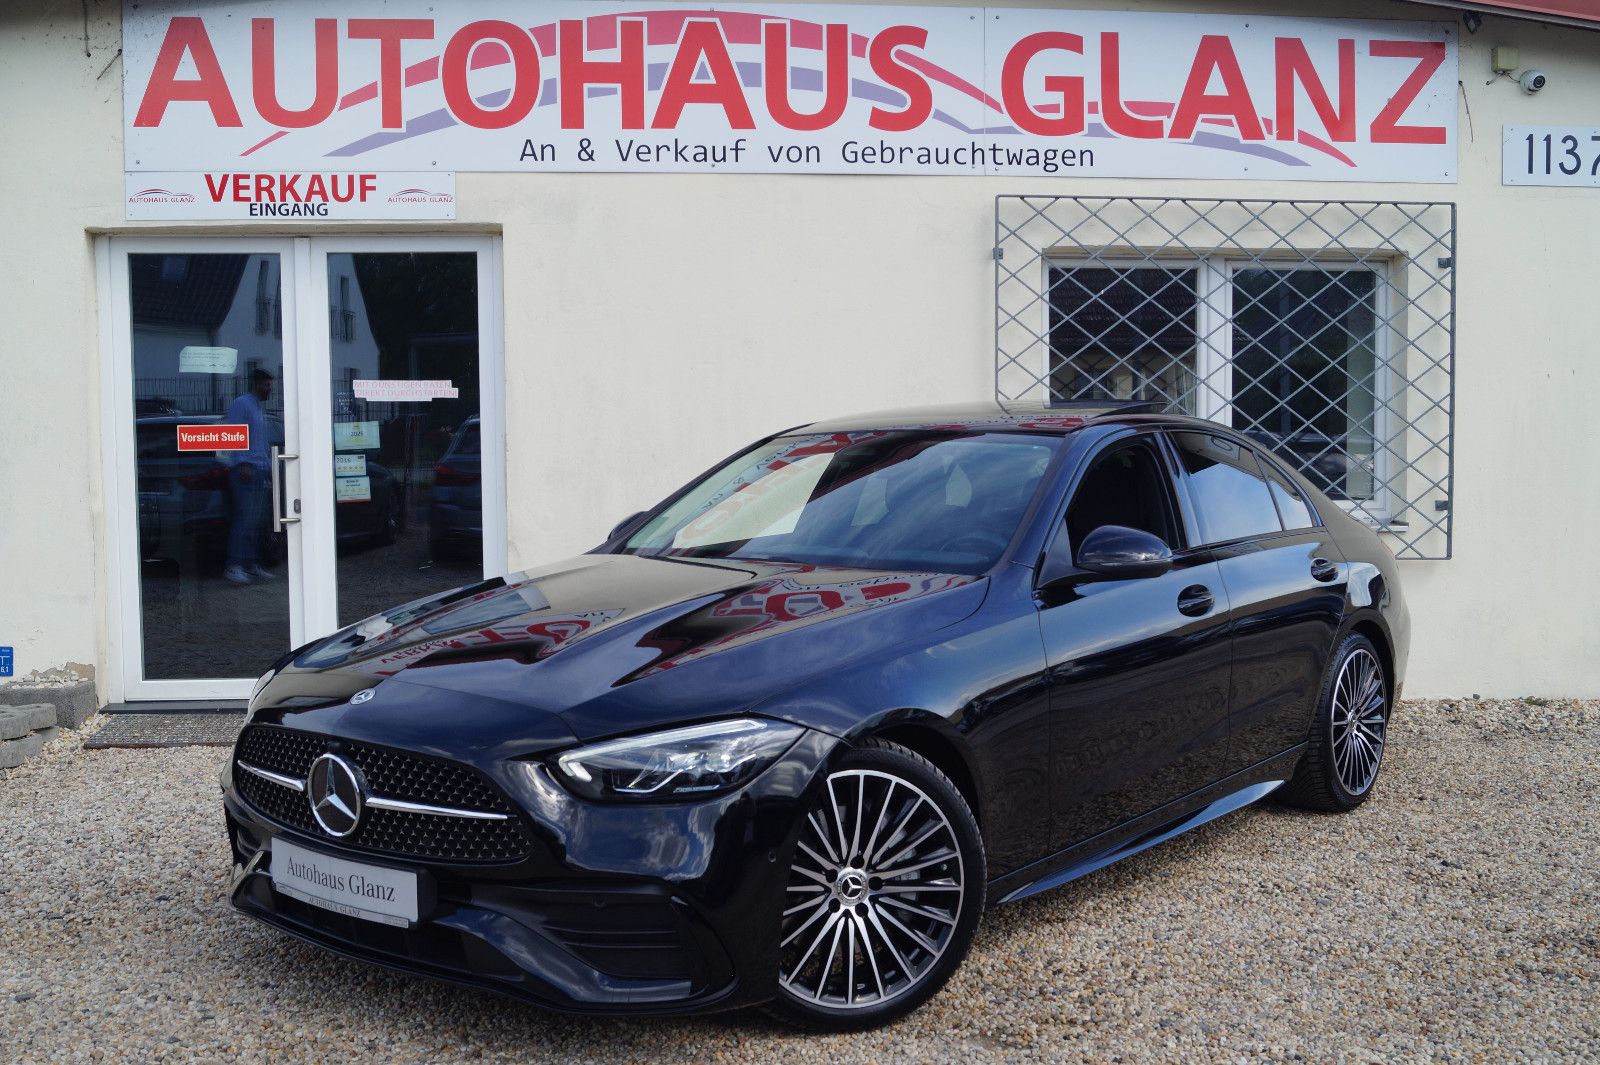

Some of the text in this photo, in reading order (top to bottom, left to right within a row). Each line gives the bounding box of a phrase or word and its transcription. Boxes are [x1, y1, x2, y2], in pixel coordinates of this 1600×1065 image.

[133, 15, 1447, 145] AUTOHAUS GLANZ
[519, 137, 1094, 173] An & Verkauf von Gebrauchtwagen
[204, 173, 377, 203] VERKAUF
[249, 202, 329, 217] EINGANG
[181, 431, 245, 443] Vorsicht Stufe
[286, 856, 395, 902] Autohaus Glanz
